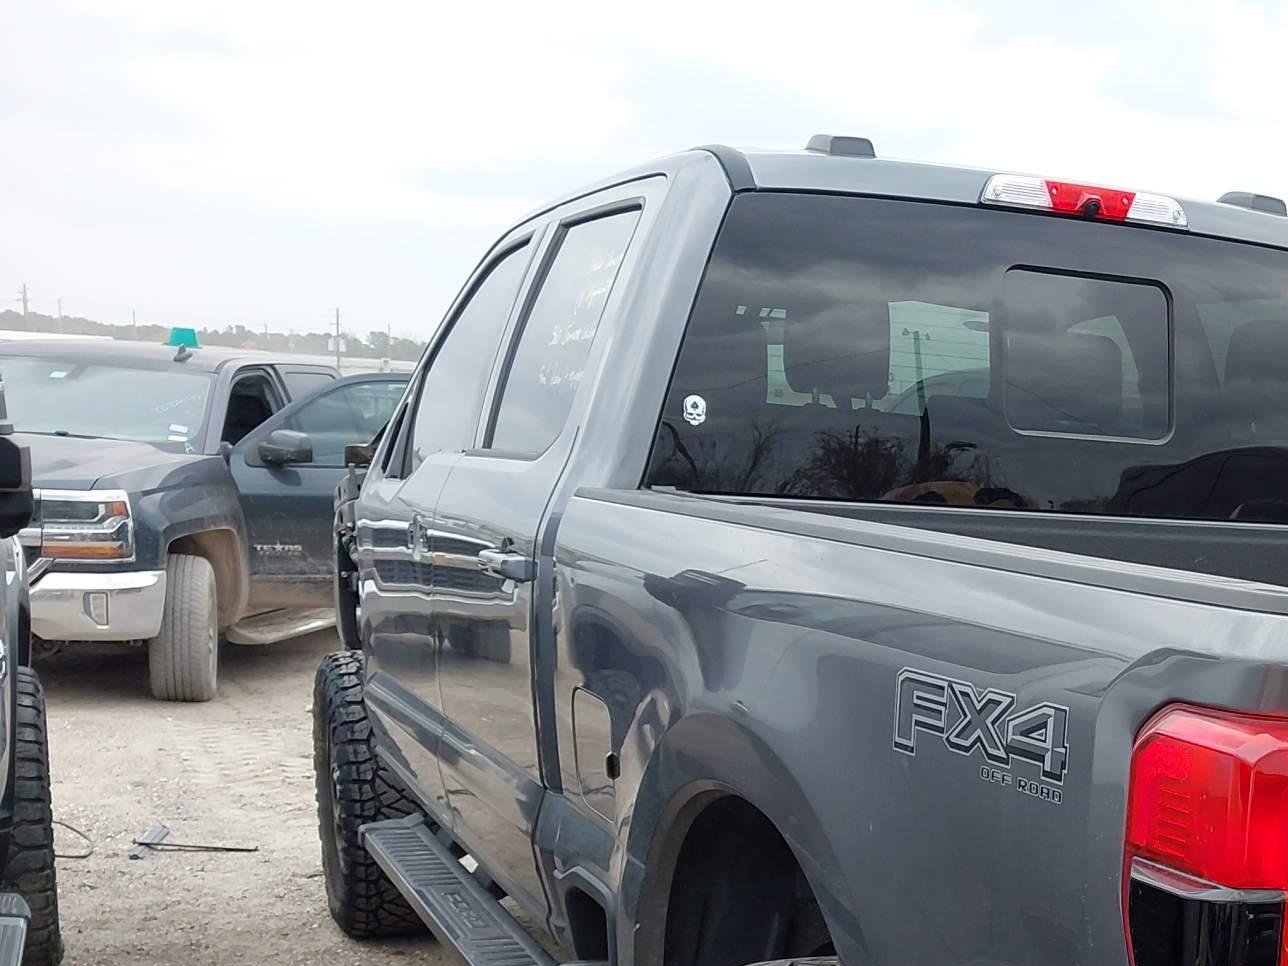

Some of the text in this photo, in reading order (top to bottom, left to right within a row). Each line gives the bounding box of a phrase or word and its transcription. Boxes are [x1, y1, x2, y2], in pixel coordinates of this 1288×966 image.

[893, 666, 1070, 785] FX4
[980, 765, 1063, 804] OFF ROAD
